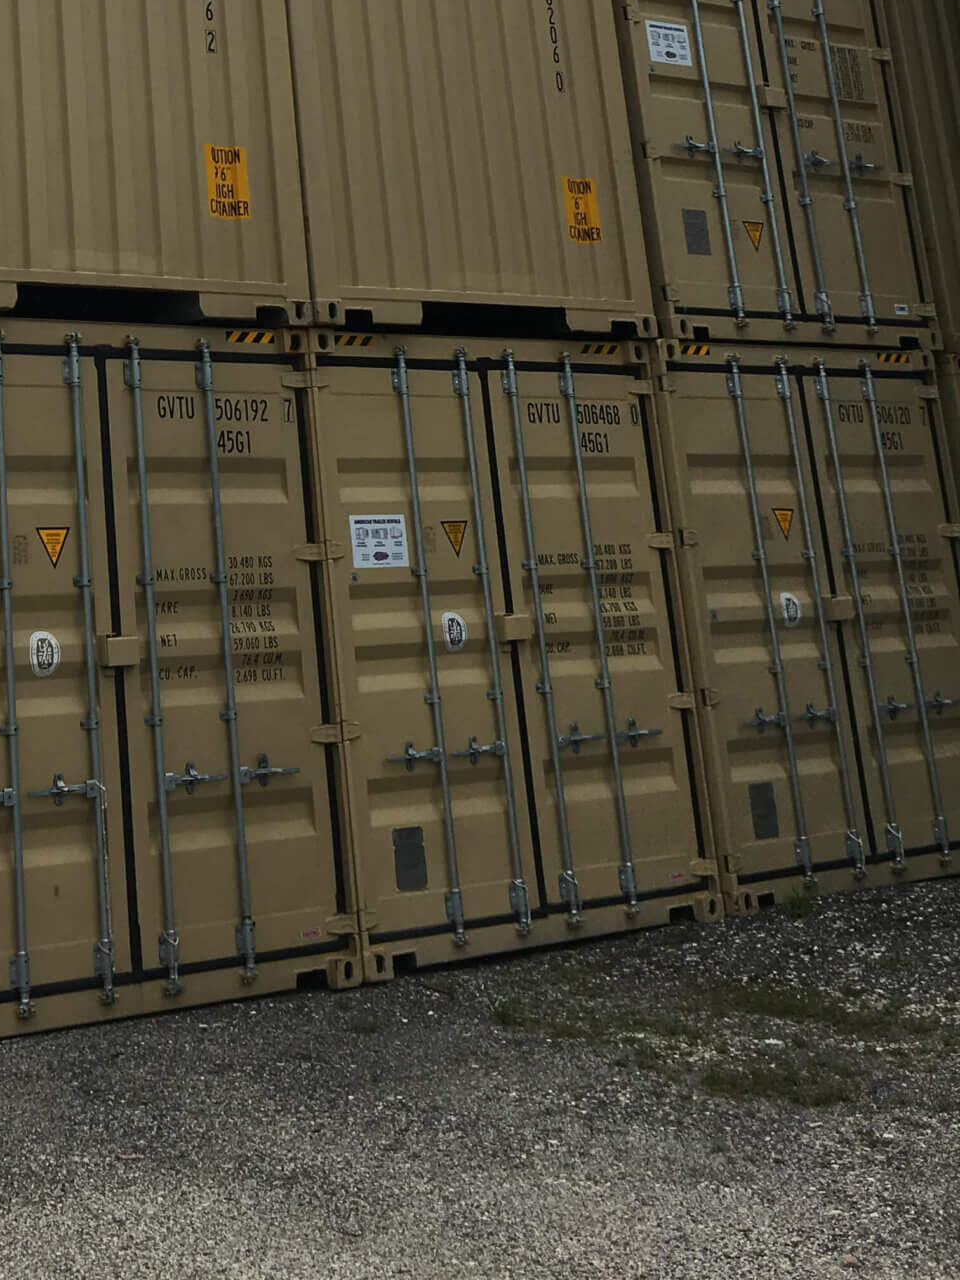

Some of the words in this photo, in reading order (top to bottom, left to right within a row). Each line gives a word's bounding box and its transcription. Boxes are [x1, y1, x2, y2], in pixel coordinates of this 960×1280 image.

[206, 30, 217, 54] 2
[157, 395, 195, 420] GVTU
[214, 397, 269, 423] 506192
[283, 399, 292, 422] 7
[527, 402, 560, 424] GVTU
[576, 403, 621, 425] 506468
[630, 403, 638, 423] 0
[838, 404, 864, 424] GVTU
[217, 430, 252, 454] 45G1
[580, 431, 609, 453] 45G1
[227, 556, 254, 569] 30.480
[258, 554, 273, 568] KGS
[557, 552, 579, 565] GROSS
[229, 573, 255, 586] 67.200
[258, 572, 274, 584] LBS
[155, 600, 180, 616] TARE
[256, 604, 271, 617] LBS
[259, 621, 275, 632] KGS
[159, 634, 178, 648] NET
[263, 636, 279, 649] LBS
